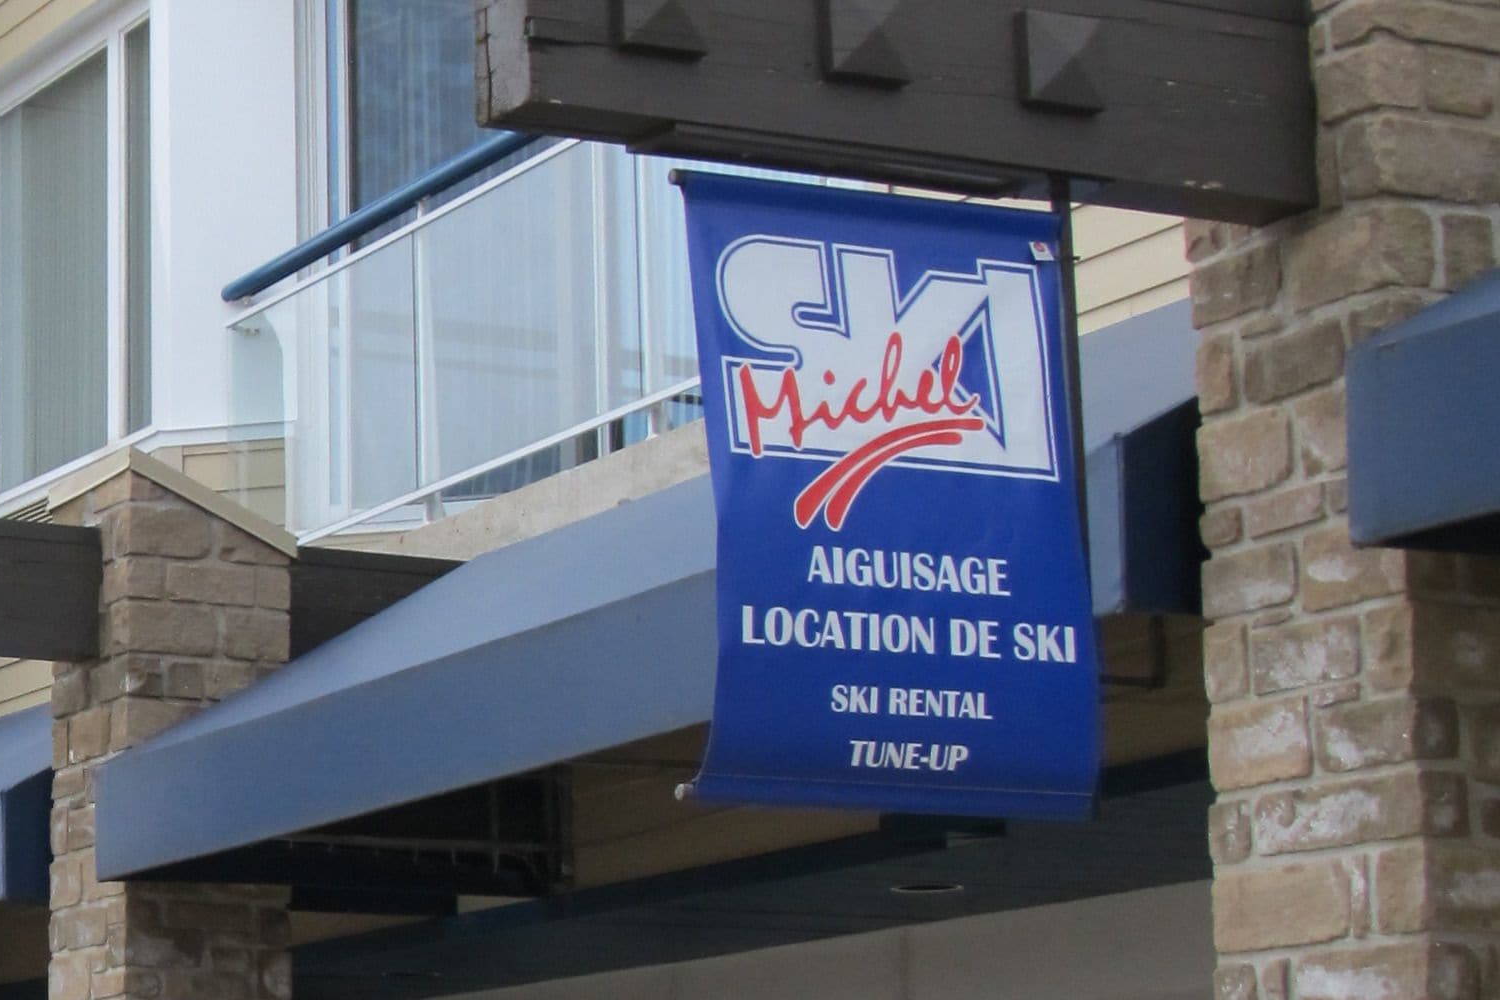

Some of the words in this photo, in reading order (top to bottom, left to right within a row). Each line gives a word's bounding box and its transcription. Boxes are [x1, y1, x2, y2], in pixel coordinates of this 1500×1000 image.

[716, 234, 1059, 482] SKI
[738, 332, 980, 458] Michel
[807, 545, 1011, 597] AIGUISAGE
[742, 605, 936, 655] LOCATION
[951, 619, 1001, 660] DE
[1013, 622, 1077, 664] SKI
[831, 684, 878, 716] SKI
[888, 687, 994, 721] RENTAL
[849, 739, 969, 773] TUNE-UP
